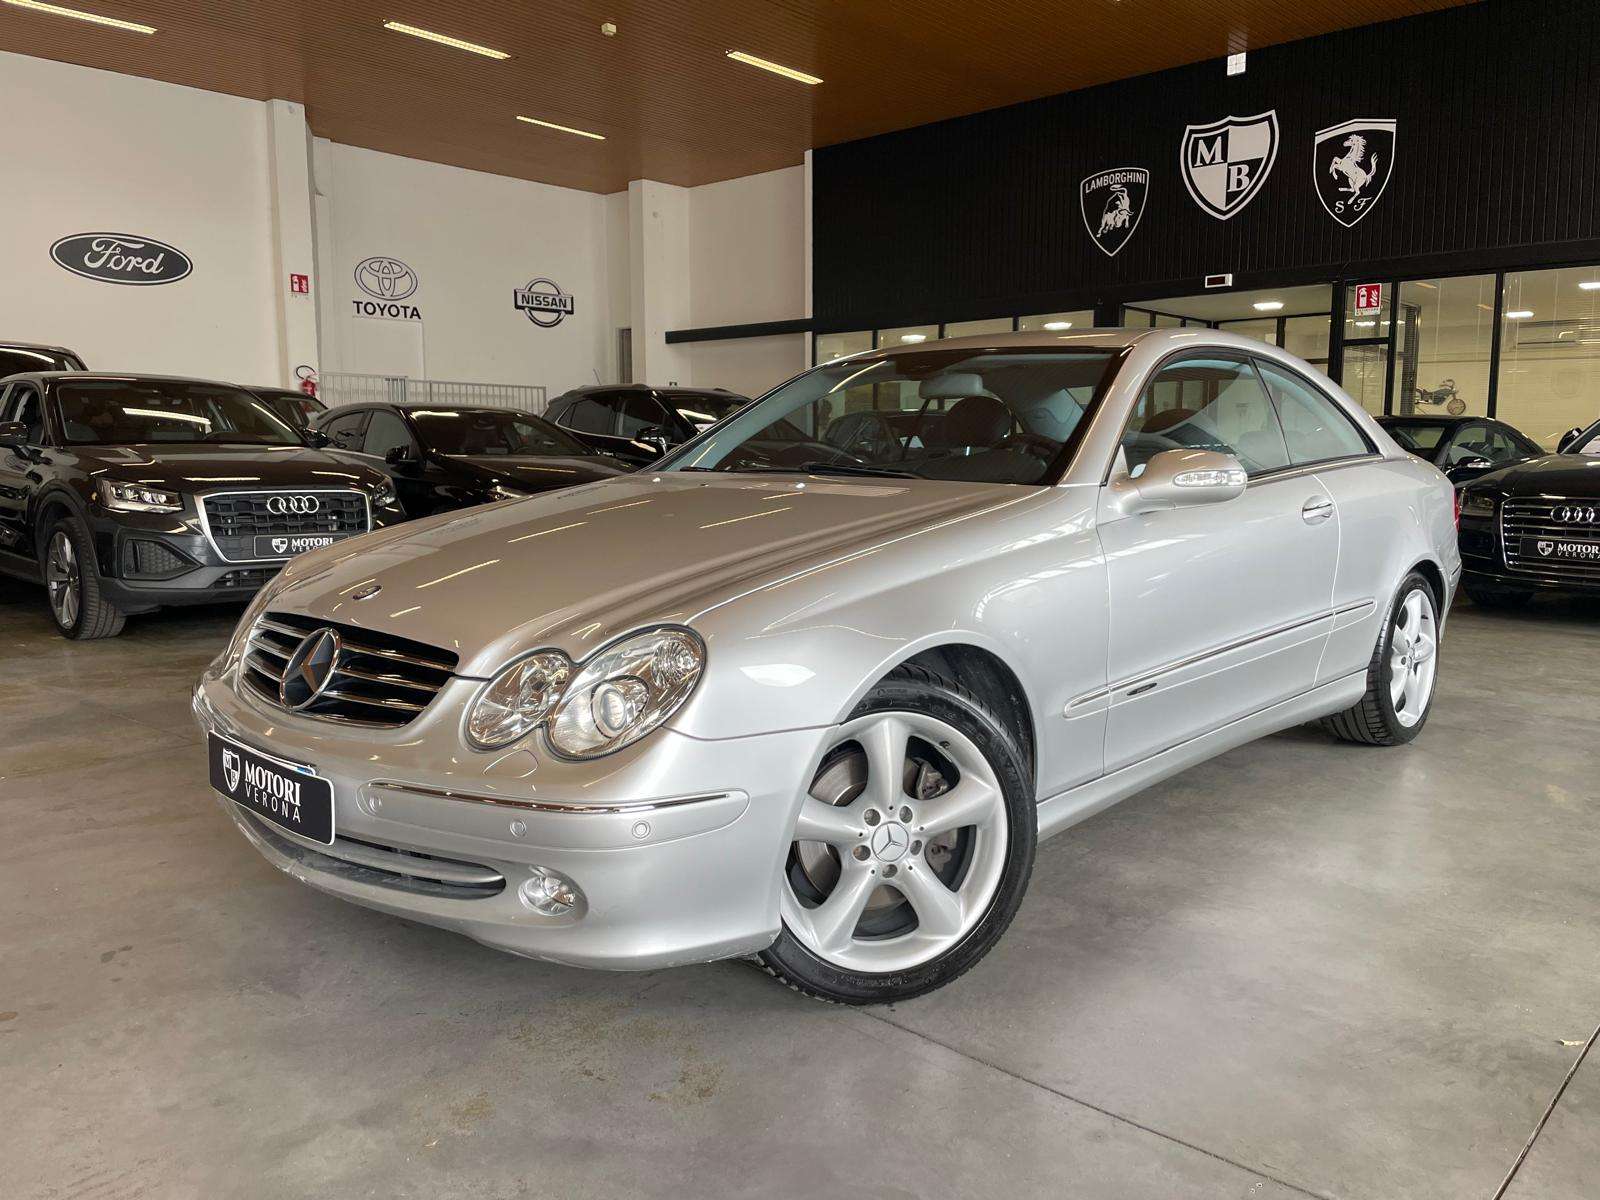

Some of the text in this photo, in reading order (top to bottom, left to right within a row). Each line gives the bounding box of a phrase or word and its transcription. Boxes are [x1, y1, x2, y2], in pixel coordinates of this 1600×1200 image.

[1194, 136, 1224, 167] M
[1085, 172, 1145, 193] LAMBORGHINI
[1227, 164, 1250, 192] B
[1334, 200, 1345, 213] S
[84, 238, 165, 274] Ford
[352, 300, 421, 320] TOYOTA
[521, 294, 567, 309] NISSAN
[292, 537, 334, 547] MOTORI
[1557, 543, 1600, 554] MOTOR
[245, 760, 301, 806] MOTORI
[245, 783, 301, 823] VERONA
